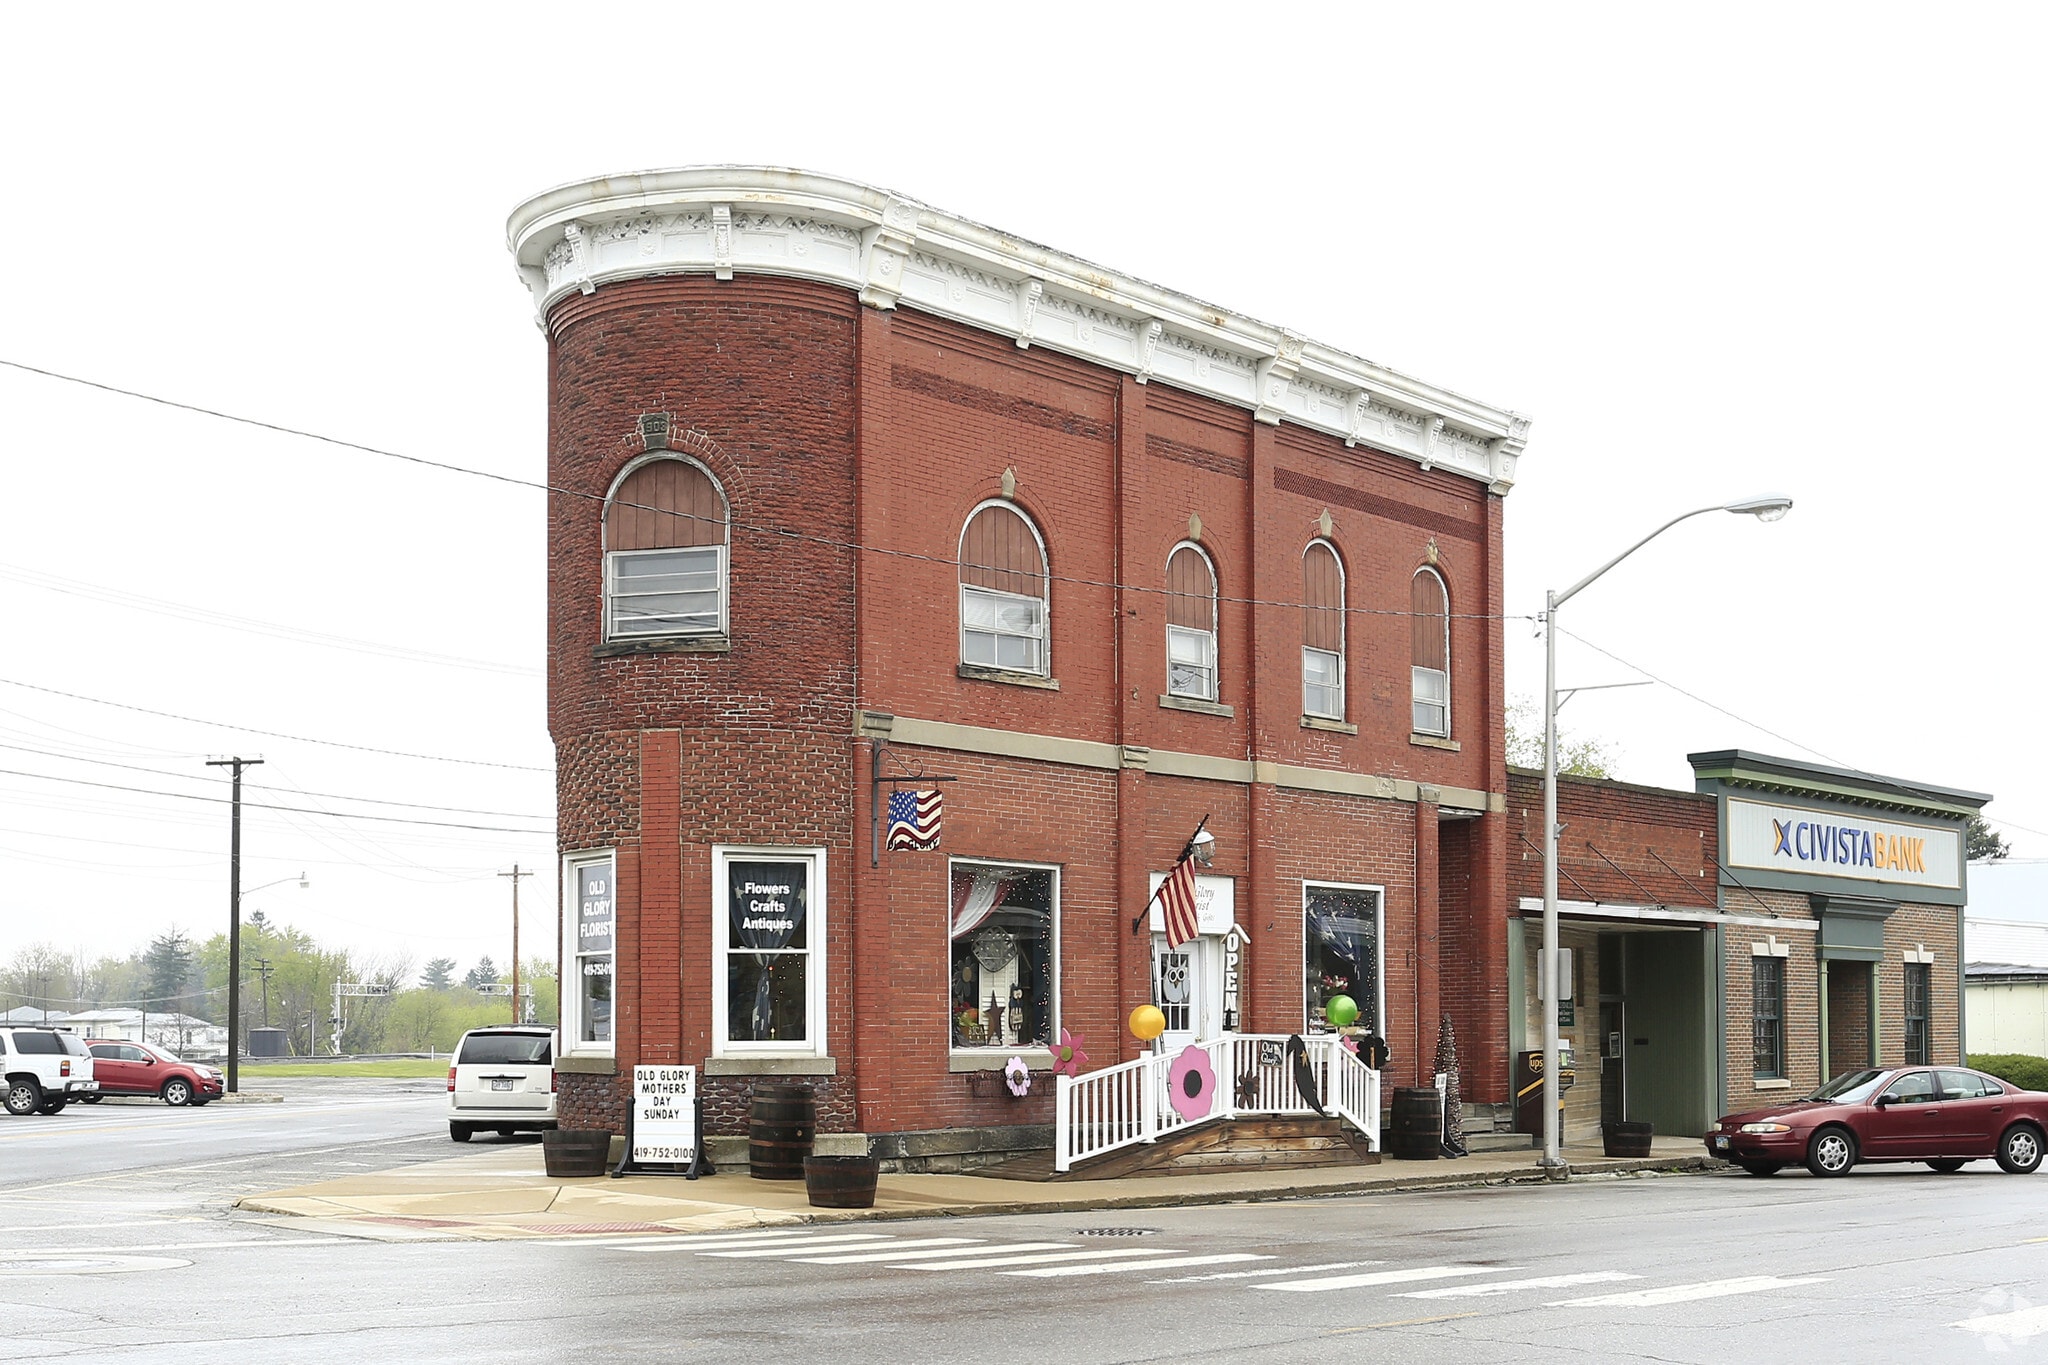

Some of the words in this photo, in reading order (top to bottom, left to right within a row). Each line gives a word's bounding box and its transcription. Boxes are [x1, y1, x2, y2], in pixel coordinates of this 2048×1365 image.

[588, 880, 606, 896] OLD
[744, 882, 791, 895] Flowers
[583, 899, 612, 917] GLORY
[749, 899, 786, 913] Crafts
[1196, 900, 1210, 911] rist
[580, 921, 612, 938] FLORIST
[742, 917, 794, 932] Antiques
[583, 963, 612, 976] 419-752-01
[1224, 933, 1240, 1012] OPEN
[1530, 1059, 1544, 1070] ups
[637, 1070, 656, 1081] OLD
[660, 1070, 690, 1081] GLORY
[641, 1083, 687, 1094] MOTHERS
[653, 1096, 671, 1107] DAY
[644, 1109, 680, 1120] SUNDAY
[634, 1147, 695, 1159] 419-752-0100
